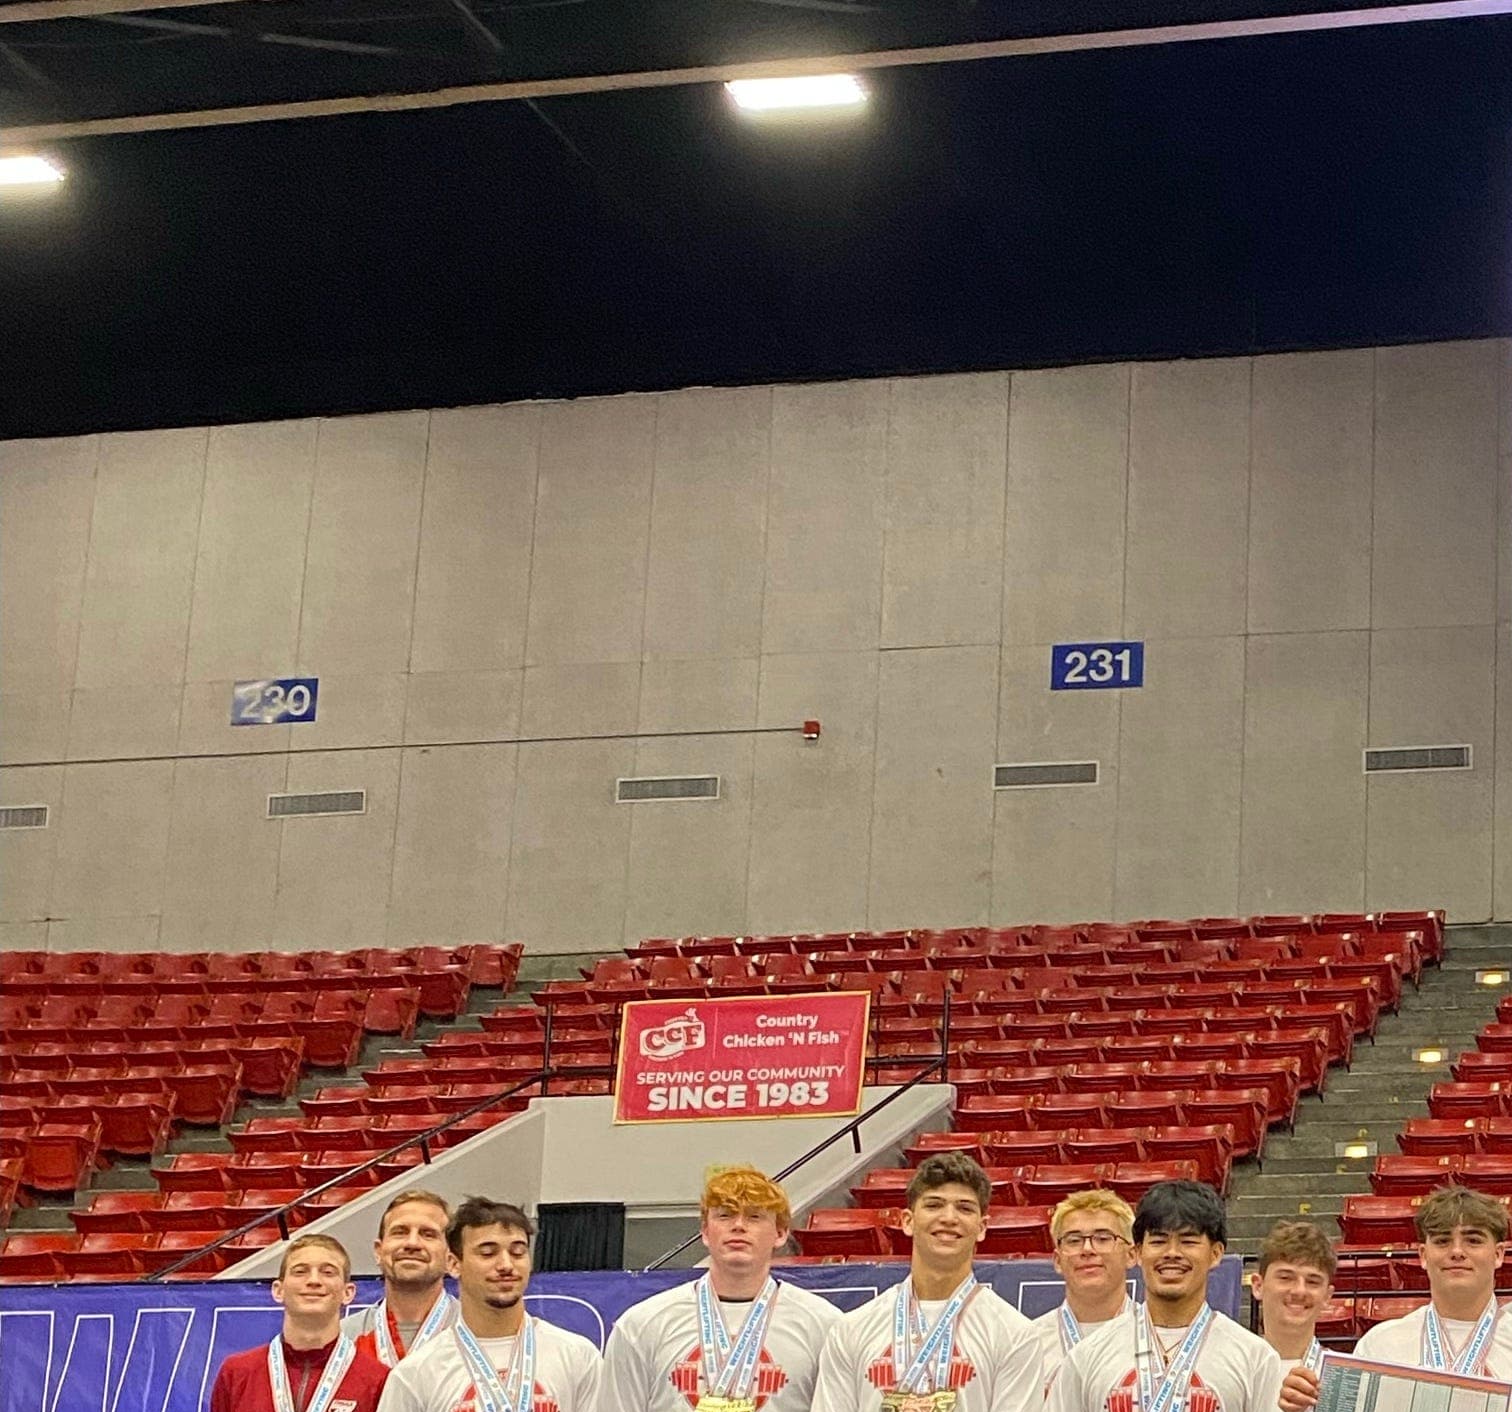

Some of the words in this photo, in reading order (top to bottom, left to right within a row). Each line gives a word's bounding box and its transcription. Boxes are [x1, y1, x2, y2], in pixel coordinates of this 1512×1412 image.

[1064, 649, 1130, 682] 231
[756, 1014, 818, 1030] Country
[645, 1024, 702, 1051] CCF
[723, 1034, 785, 1048] Chicken
[808, 1031, 839, 1045] Fish
[637, 1071, 705, 1085] SERVING
[709, 1069, 743, 1083] OUR
[747, 1065, 845, 1081] COMMUNITY
[647, 1084, 747, 1111] SINCE
[756, 1082, 829, 1107] 1983
[728, 1301, 765, 1367] WEIGHTLIFTING
[916, 1299, 960, 1365] WEIGHTLIFTING
